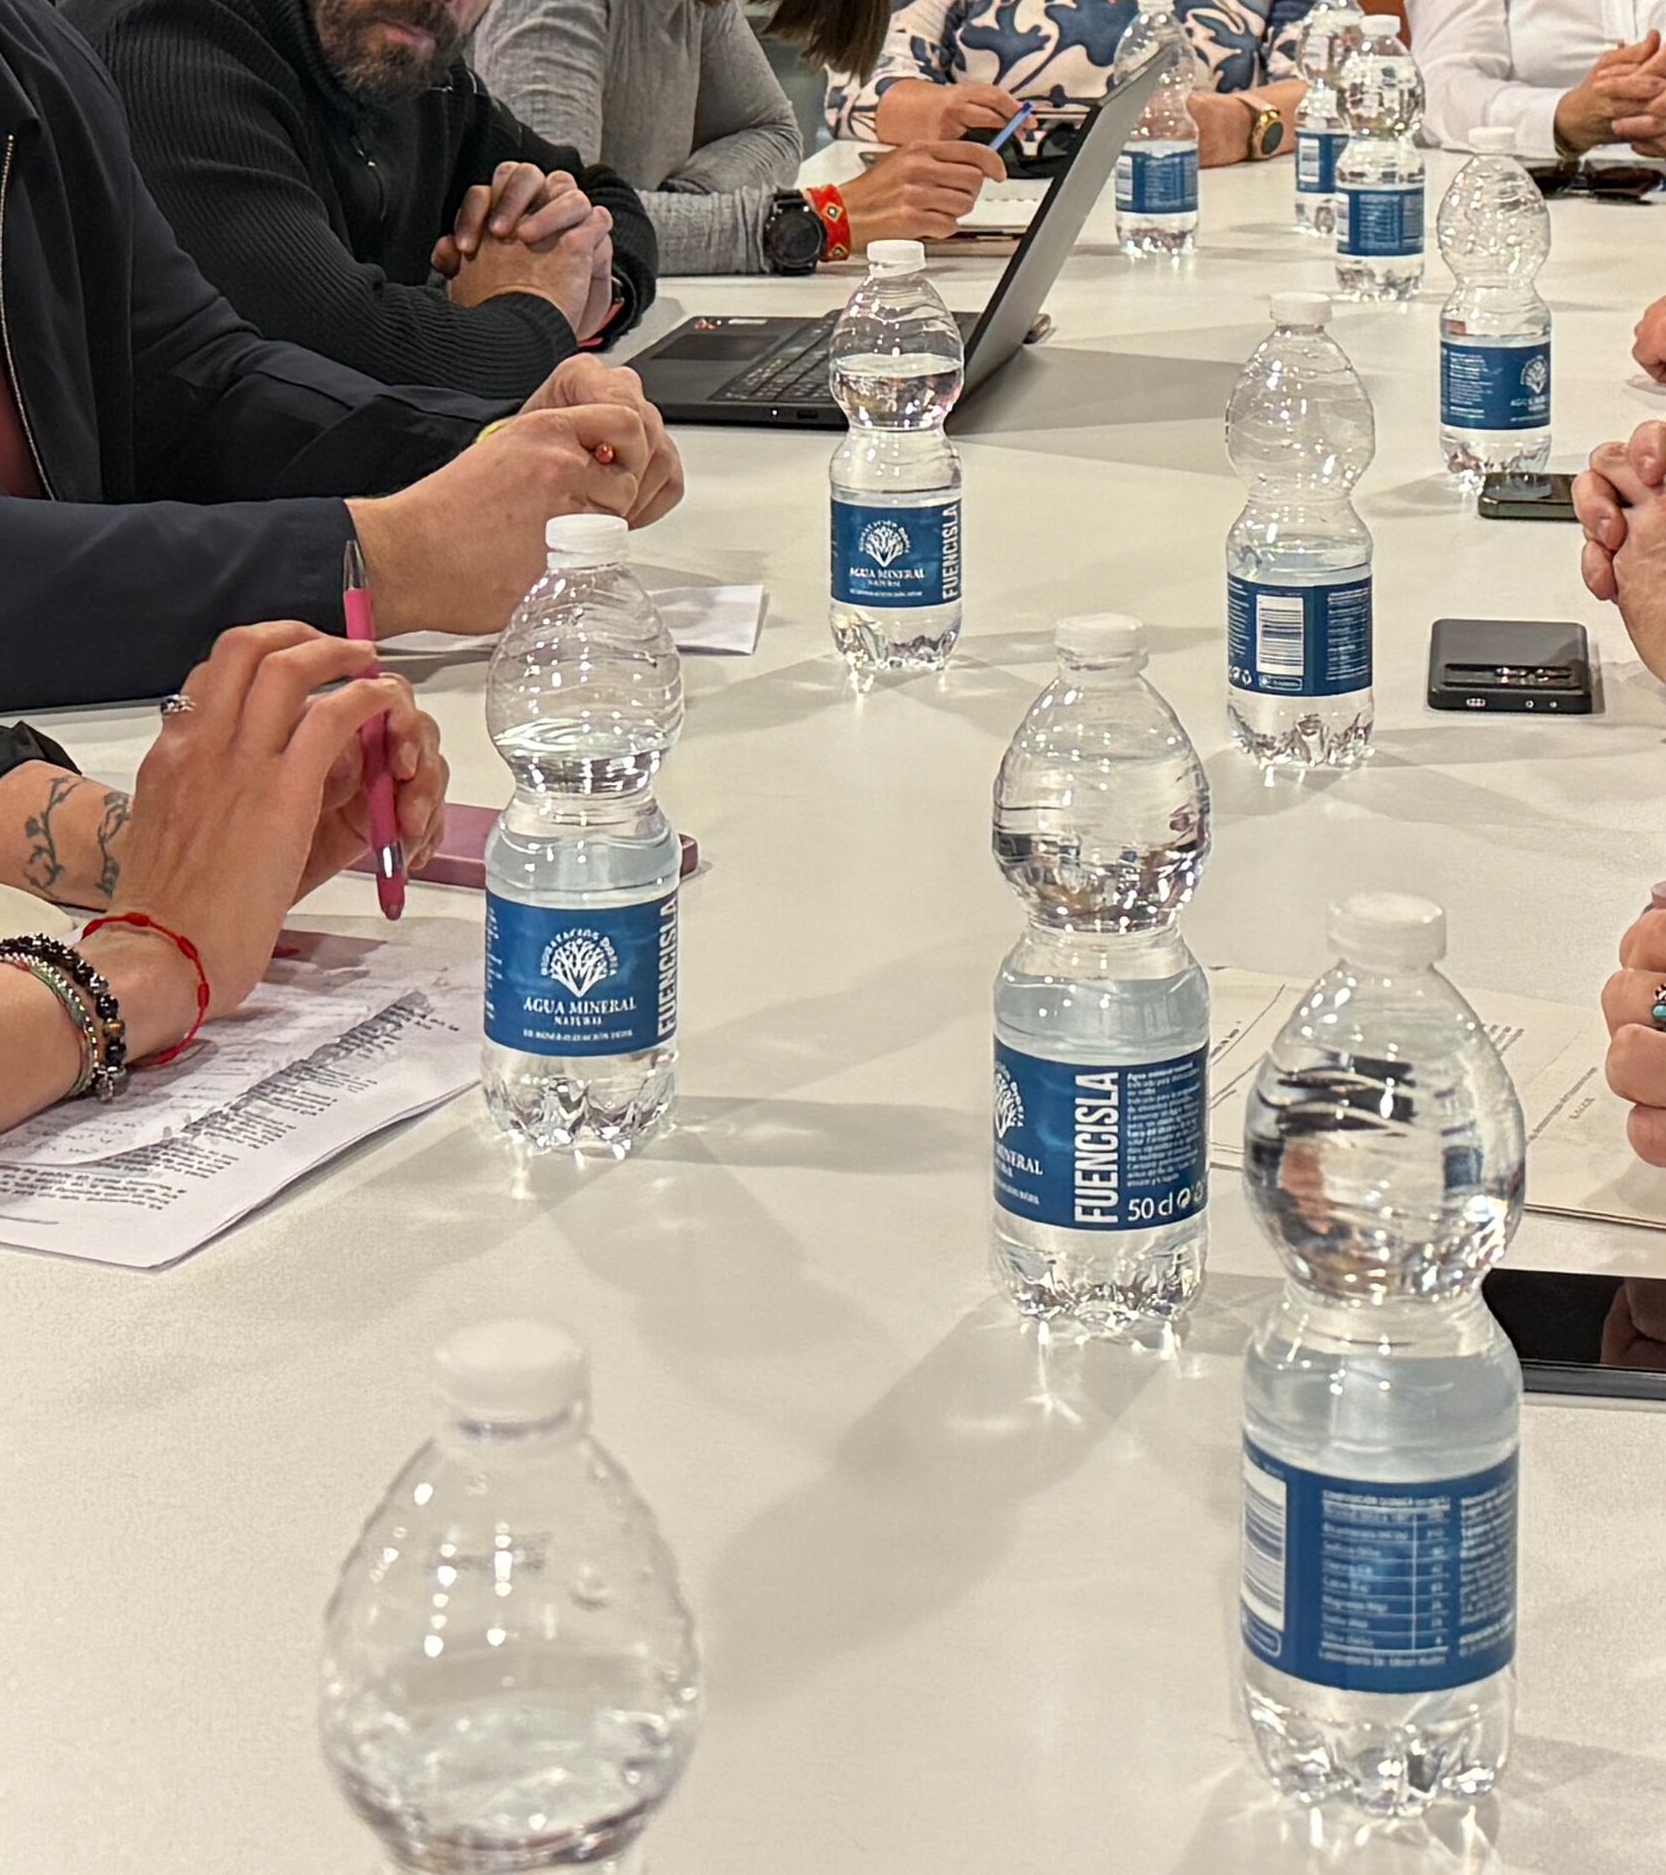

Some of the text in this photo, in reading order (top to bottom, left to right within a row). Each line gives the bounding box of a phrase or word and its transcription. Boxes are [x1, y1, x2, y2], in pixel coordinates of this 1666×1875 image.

[942, 504, 958, 599] FUENCISLA
[523, 995, 637, 1017] AGUA MINERAL
[657, 895, 679, 1037] FUENCISLA
[1074, 1071, 1119, 1223] FUENCISLA
[1127, 1192, 1174, 1222] 50 cl
